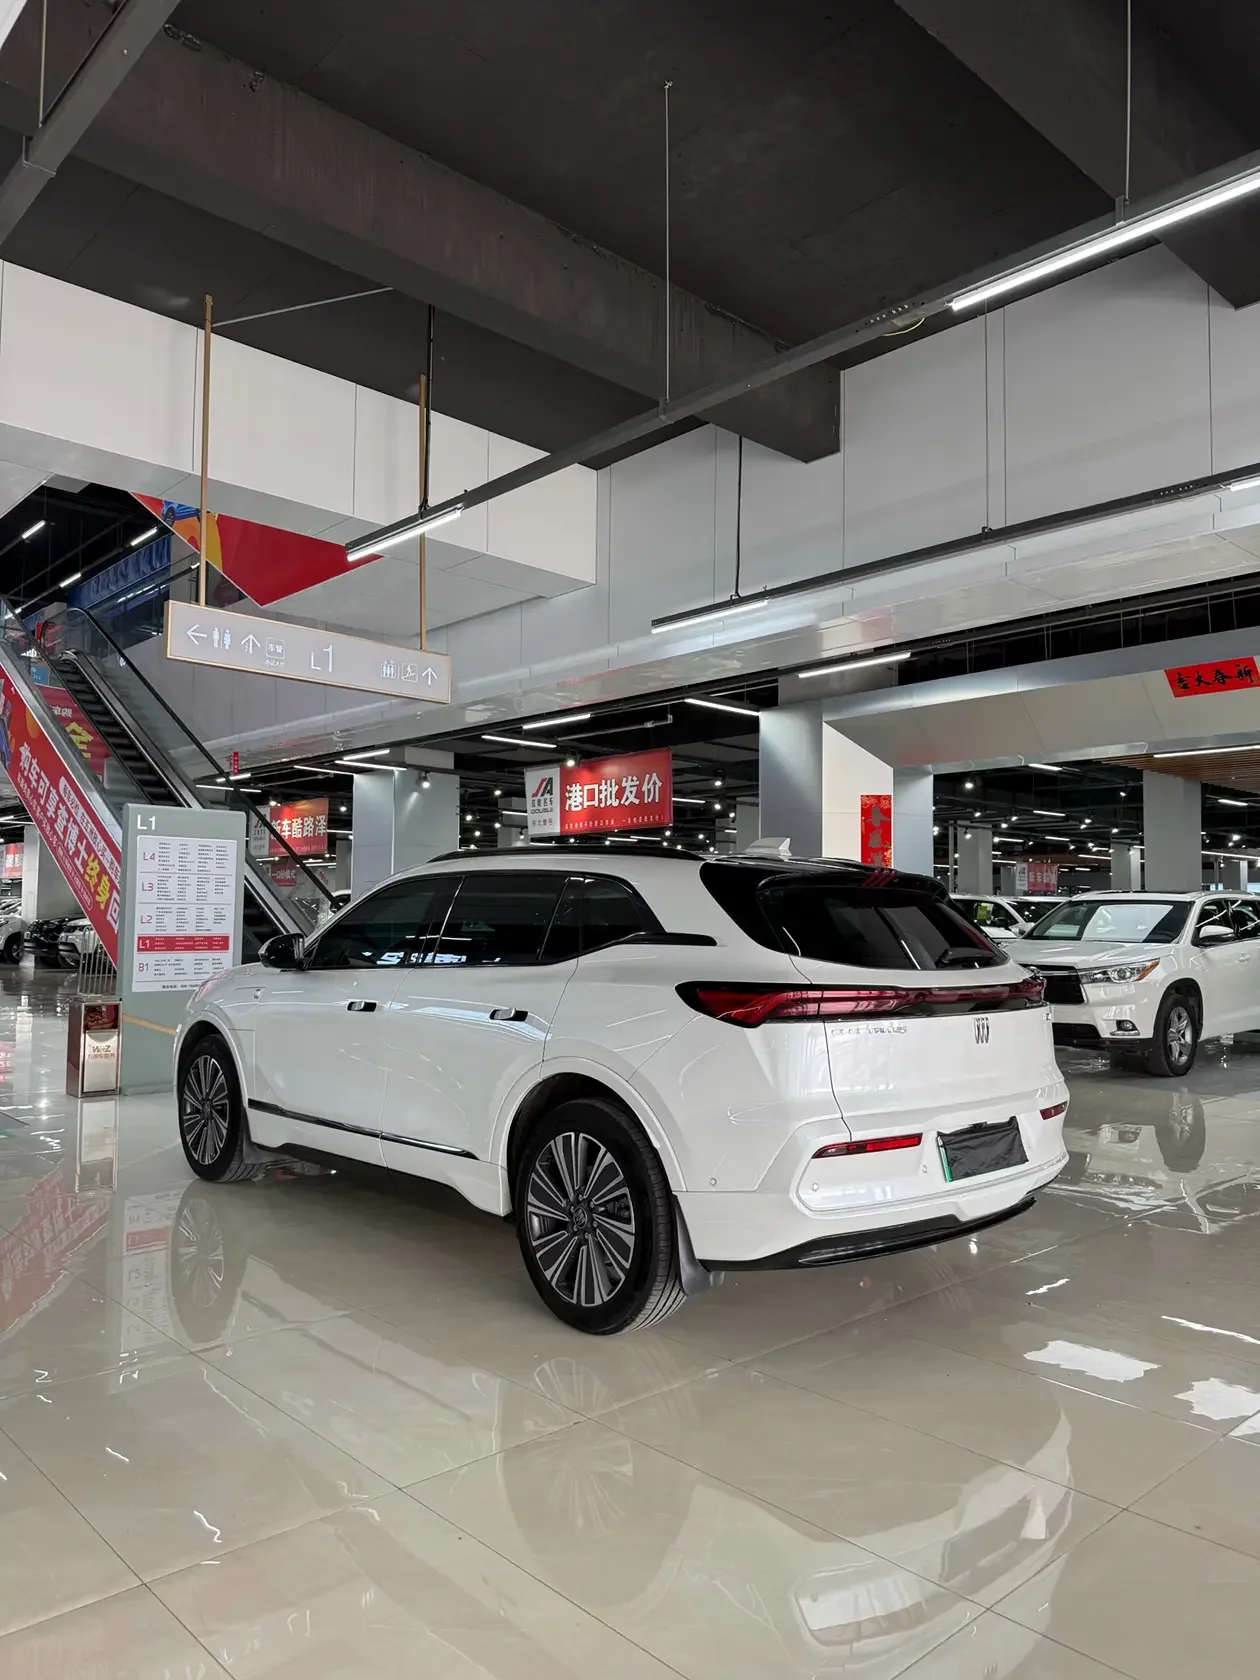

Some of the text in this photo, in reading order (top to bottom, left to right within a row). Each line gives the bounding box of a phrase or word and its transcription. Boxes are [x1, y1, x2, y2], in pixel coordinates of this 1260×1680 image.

[267, 643, 284, 654] 车管
[310, 644, 333, 673] L1
[564, 772, 663, 812] 港口批发价
[137, 814, 156, 831] L1
[142, 851, 157, 861] L4
[141, 881, 154, 892] L3
[140, 914, 153, 925] L2
[139, 939, 150, 949] L1
[138, 962, 149, 972] B1
